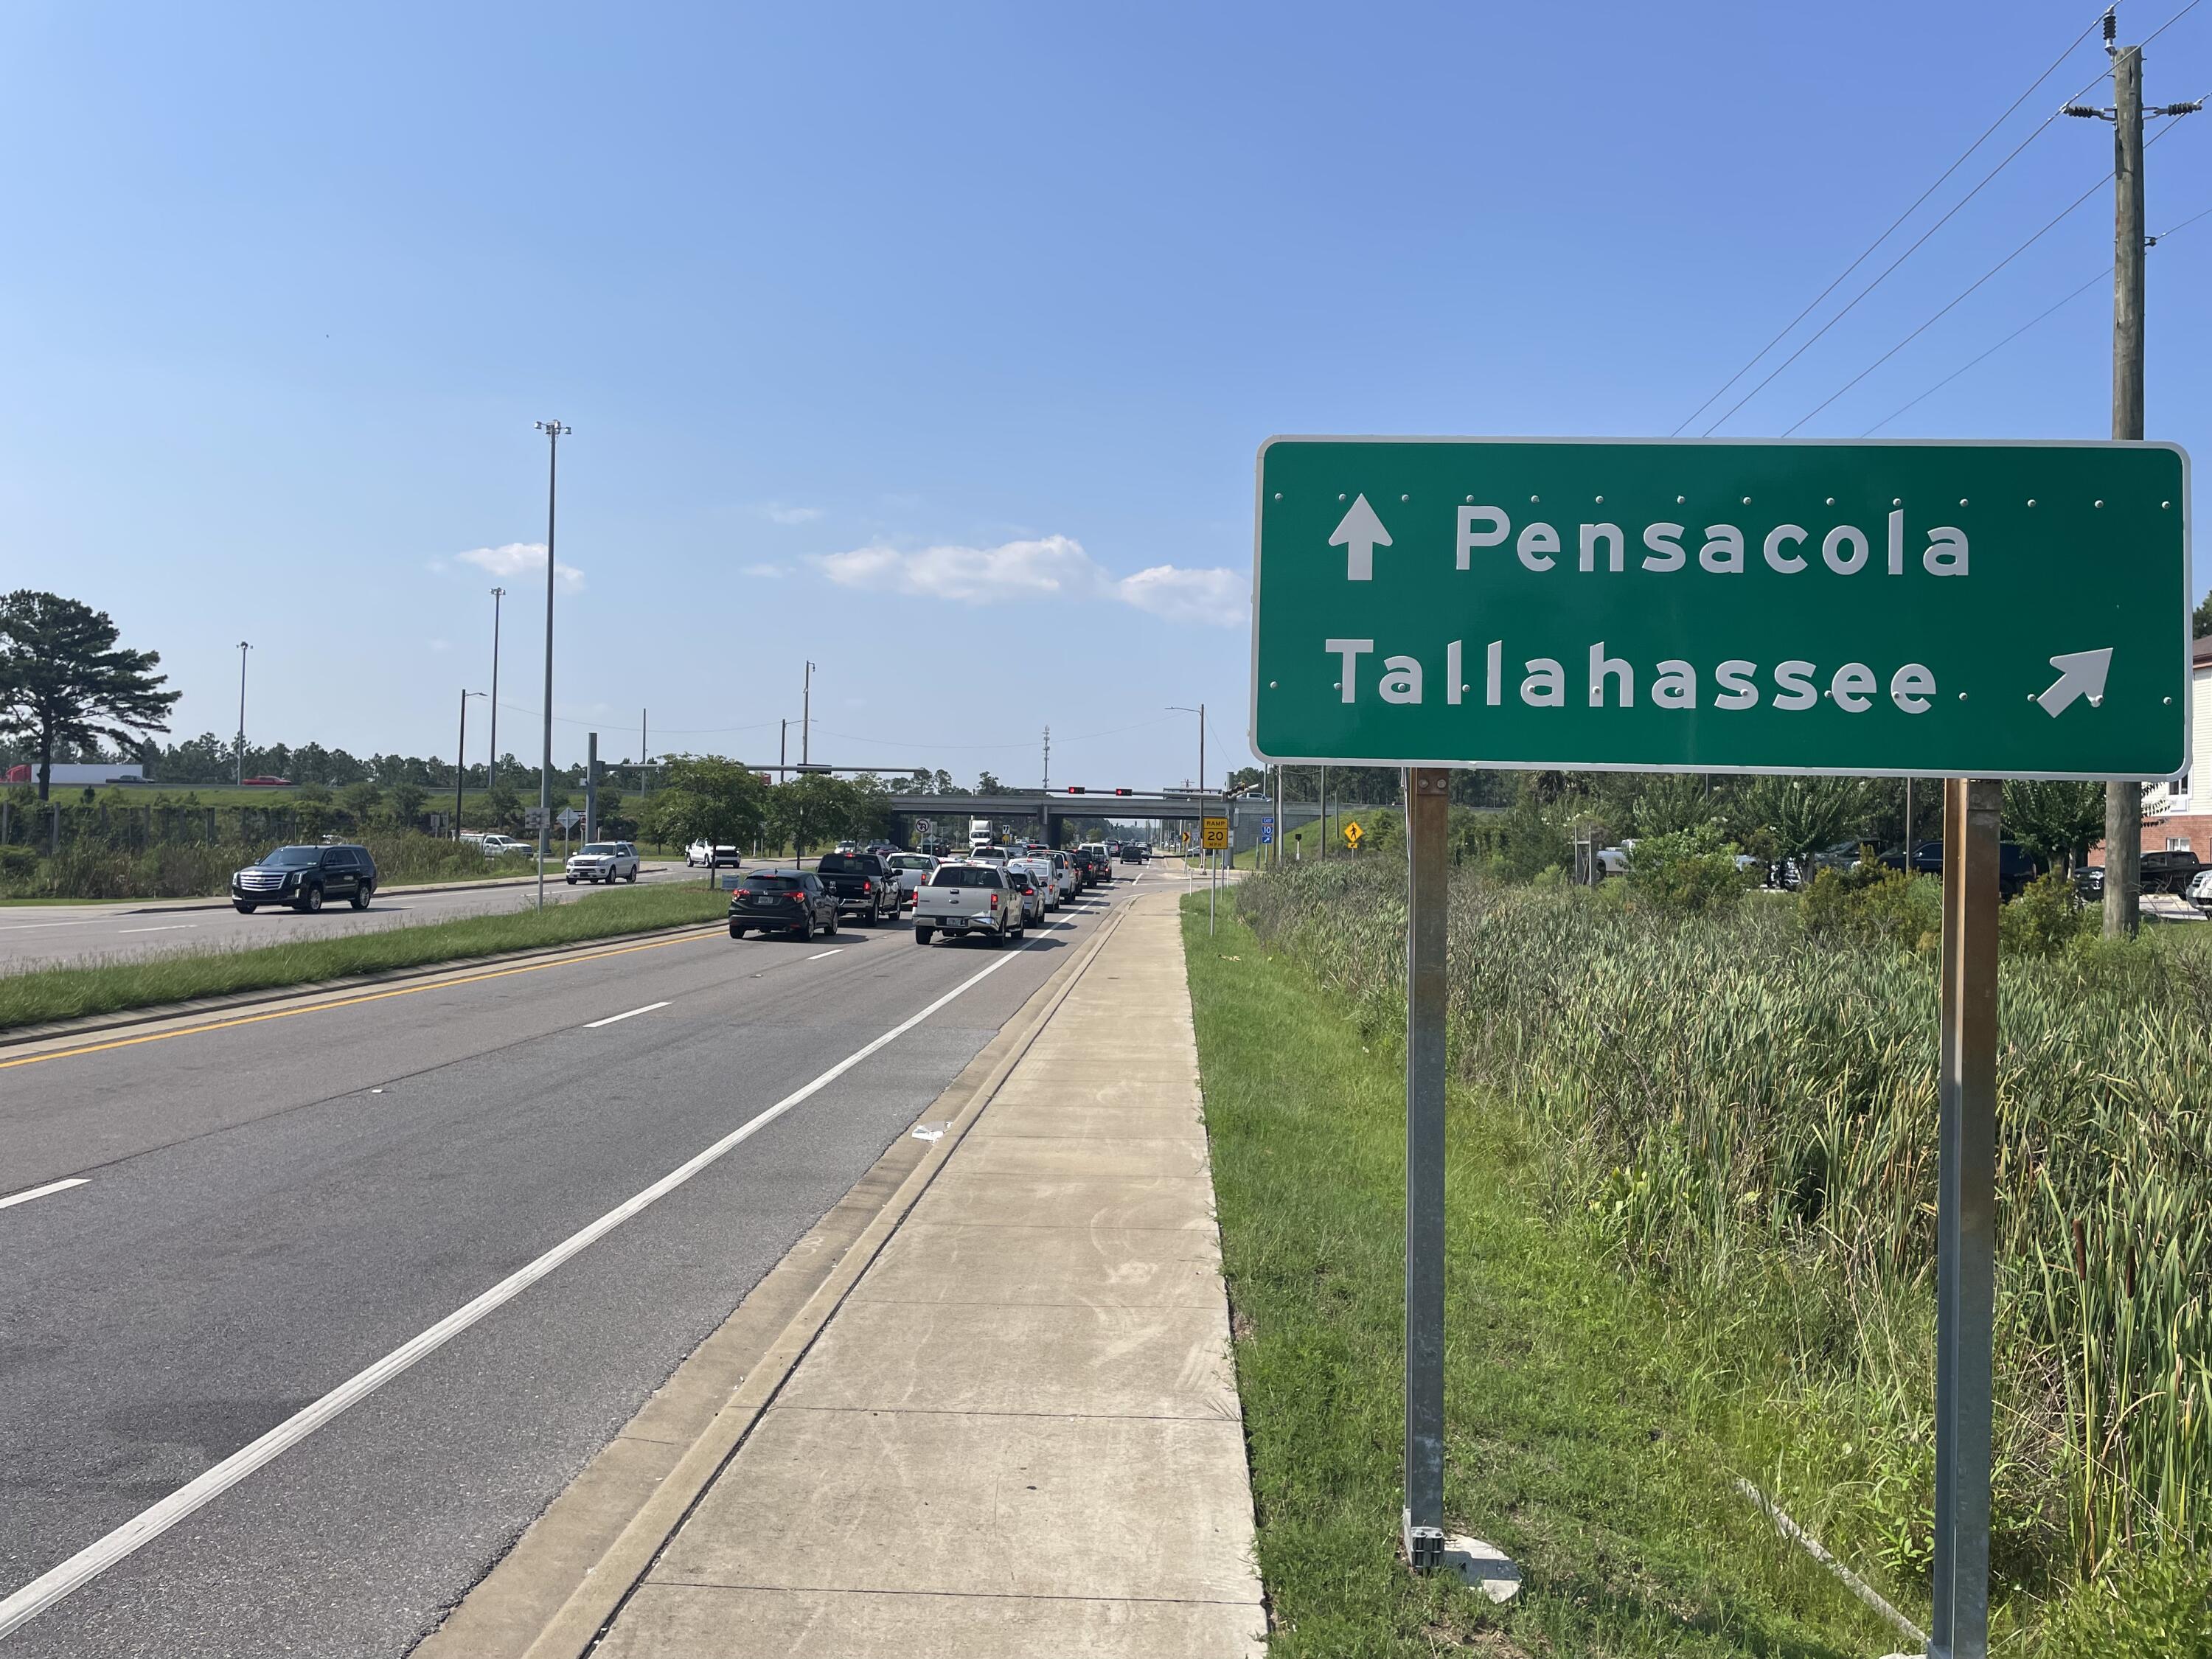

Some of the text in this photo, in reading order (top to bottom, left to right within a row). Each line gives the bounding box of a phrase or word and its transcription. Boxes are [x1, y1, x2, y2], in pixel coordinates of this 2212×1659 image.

[1455, 504, 1969, 578] Pensacola
[1324, 638, 1938, 714] Tallahassee
[1208, 832, 1224, 841] 20
